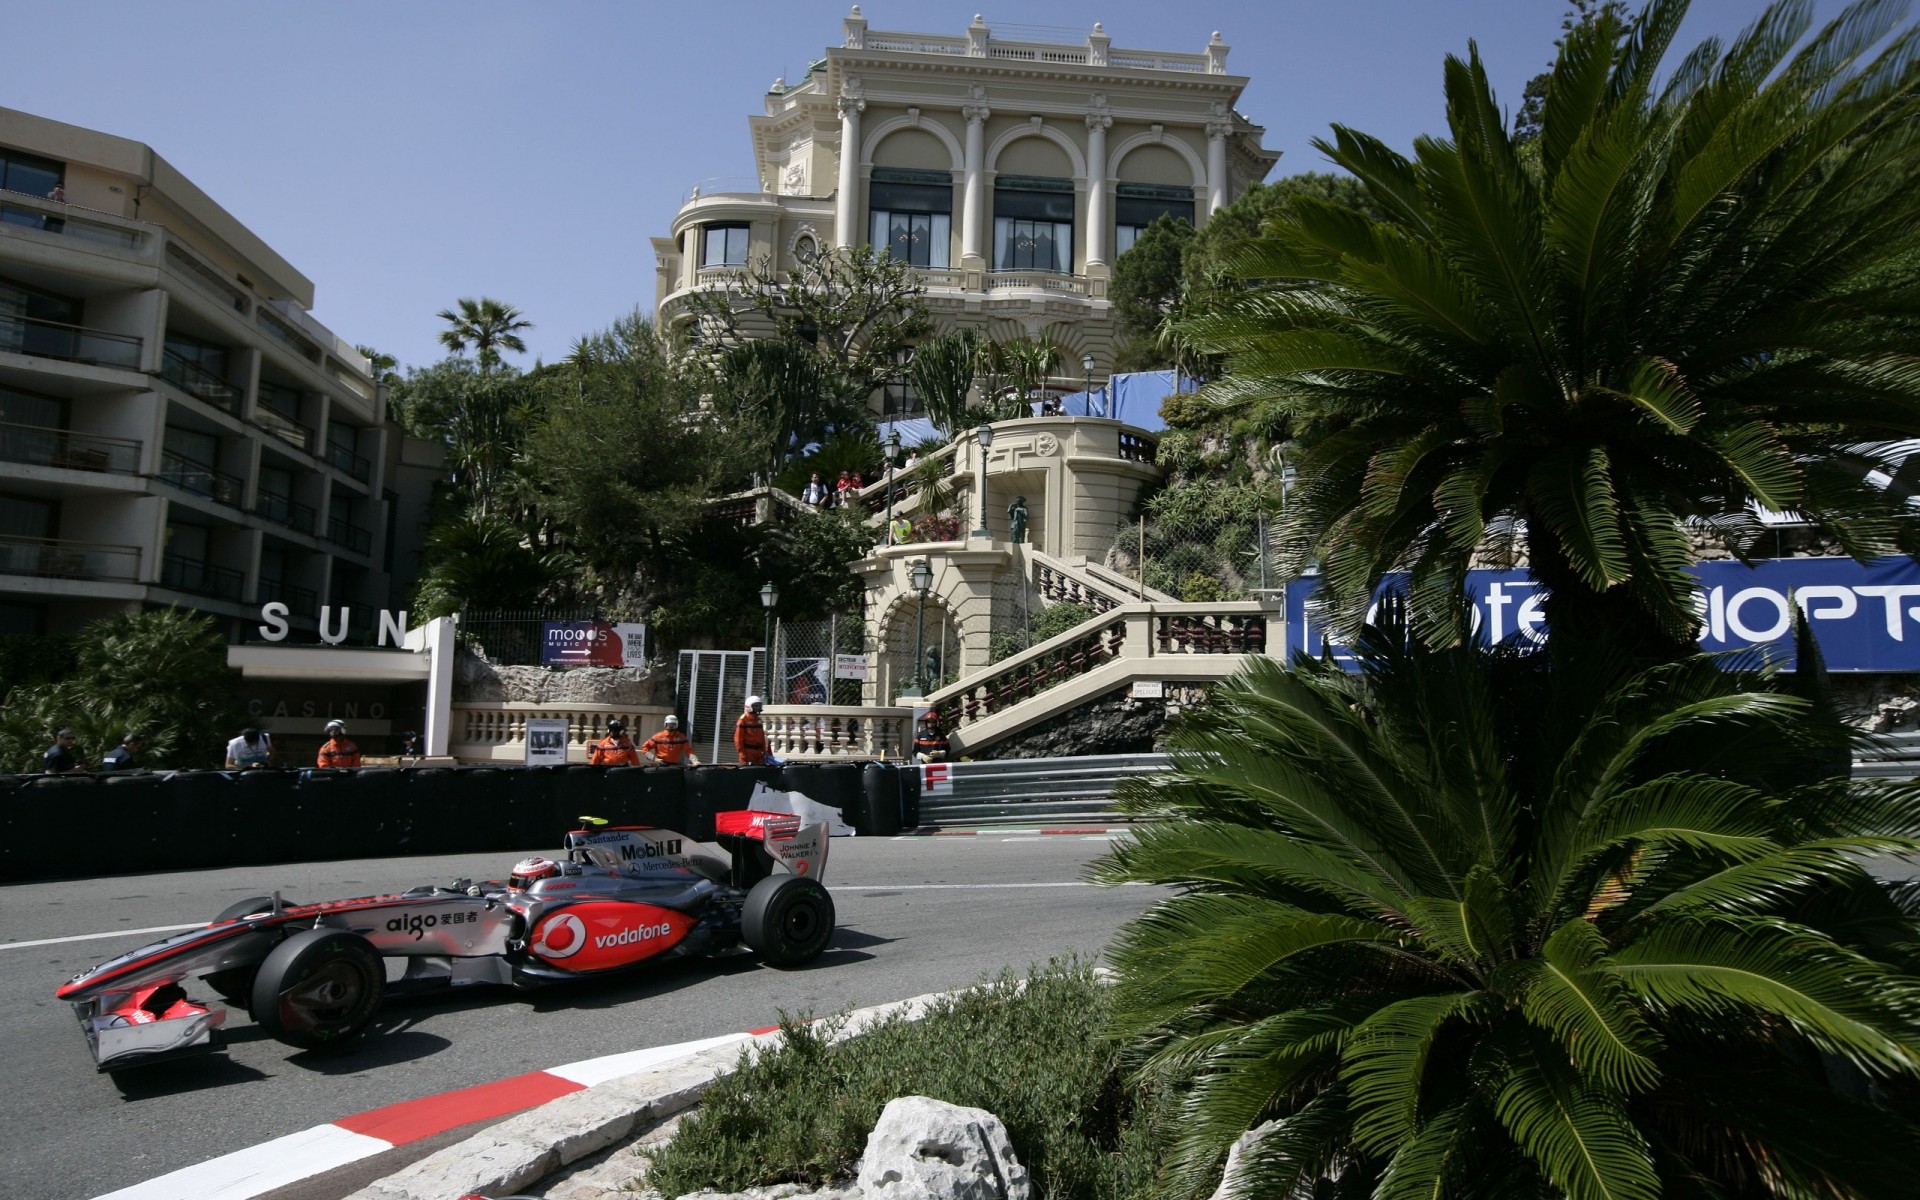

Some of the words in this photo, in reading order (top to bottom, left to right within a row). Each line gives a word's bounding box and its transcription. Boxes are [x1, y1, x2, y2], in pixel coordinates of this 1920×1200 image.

[1690, 584, 1920, 643] IOPT
[259, 602, 408, 648] SUN
[549, 627, 608, 641] moods
[627, 651, 642, 659] LIVES
[249, 699, 385, 720] CASINO
[926, 764, 948, 791] F
[586, 832, 631, 845] Santander
[622, 841, 664, 861] Mobil
[780, 842, 810, 852] JOHNNIE
[780, 850, 809, 860] WALKER
[643, 857, 703, 873] Mercedes-Benz
[544, 881, 577, 890] vodafone
[441, 911, 479, 925] 爱国者
[386, 914, 437, 941] aigo
[595, 922, 671, 949] vodafone
